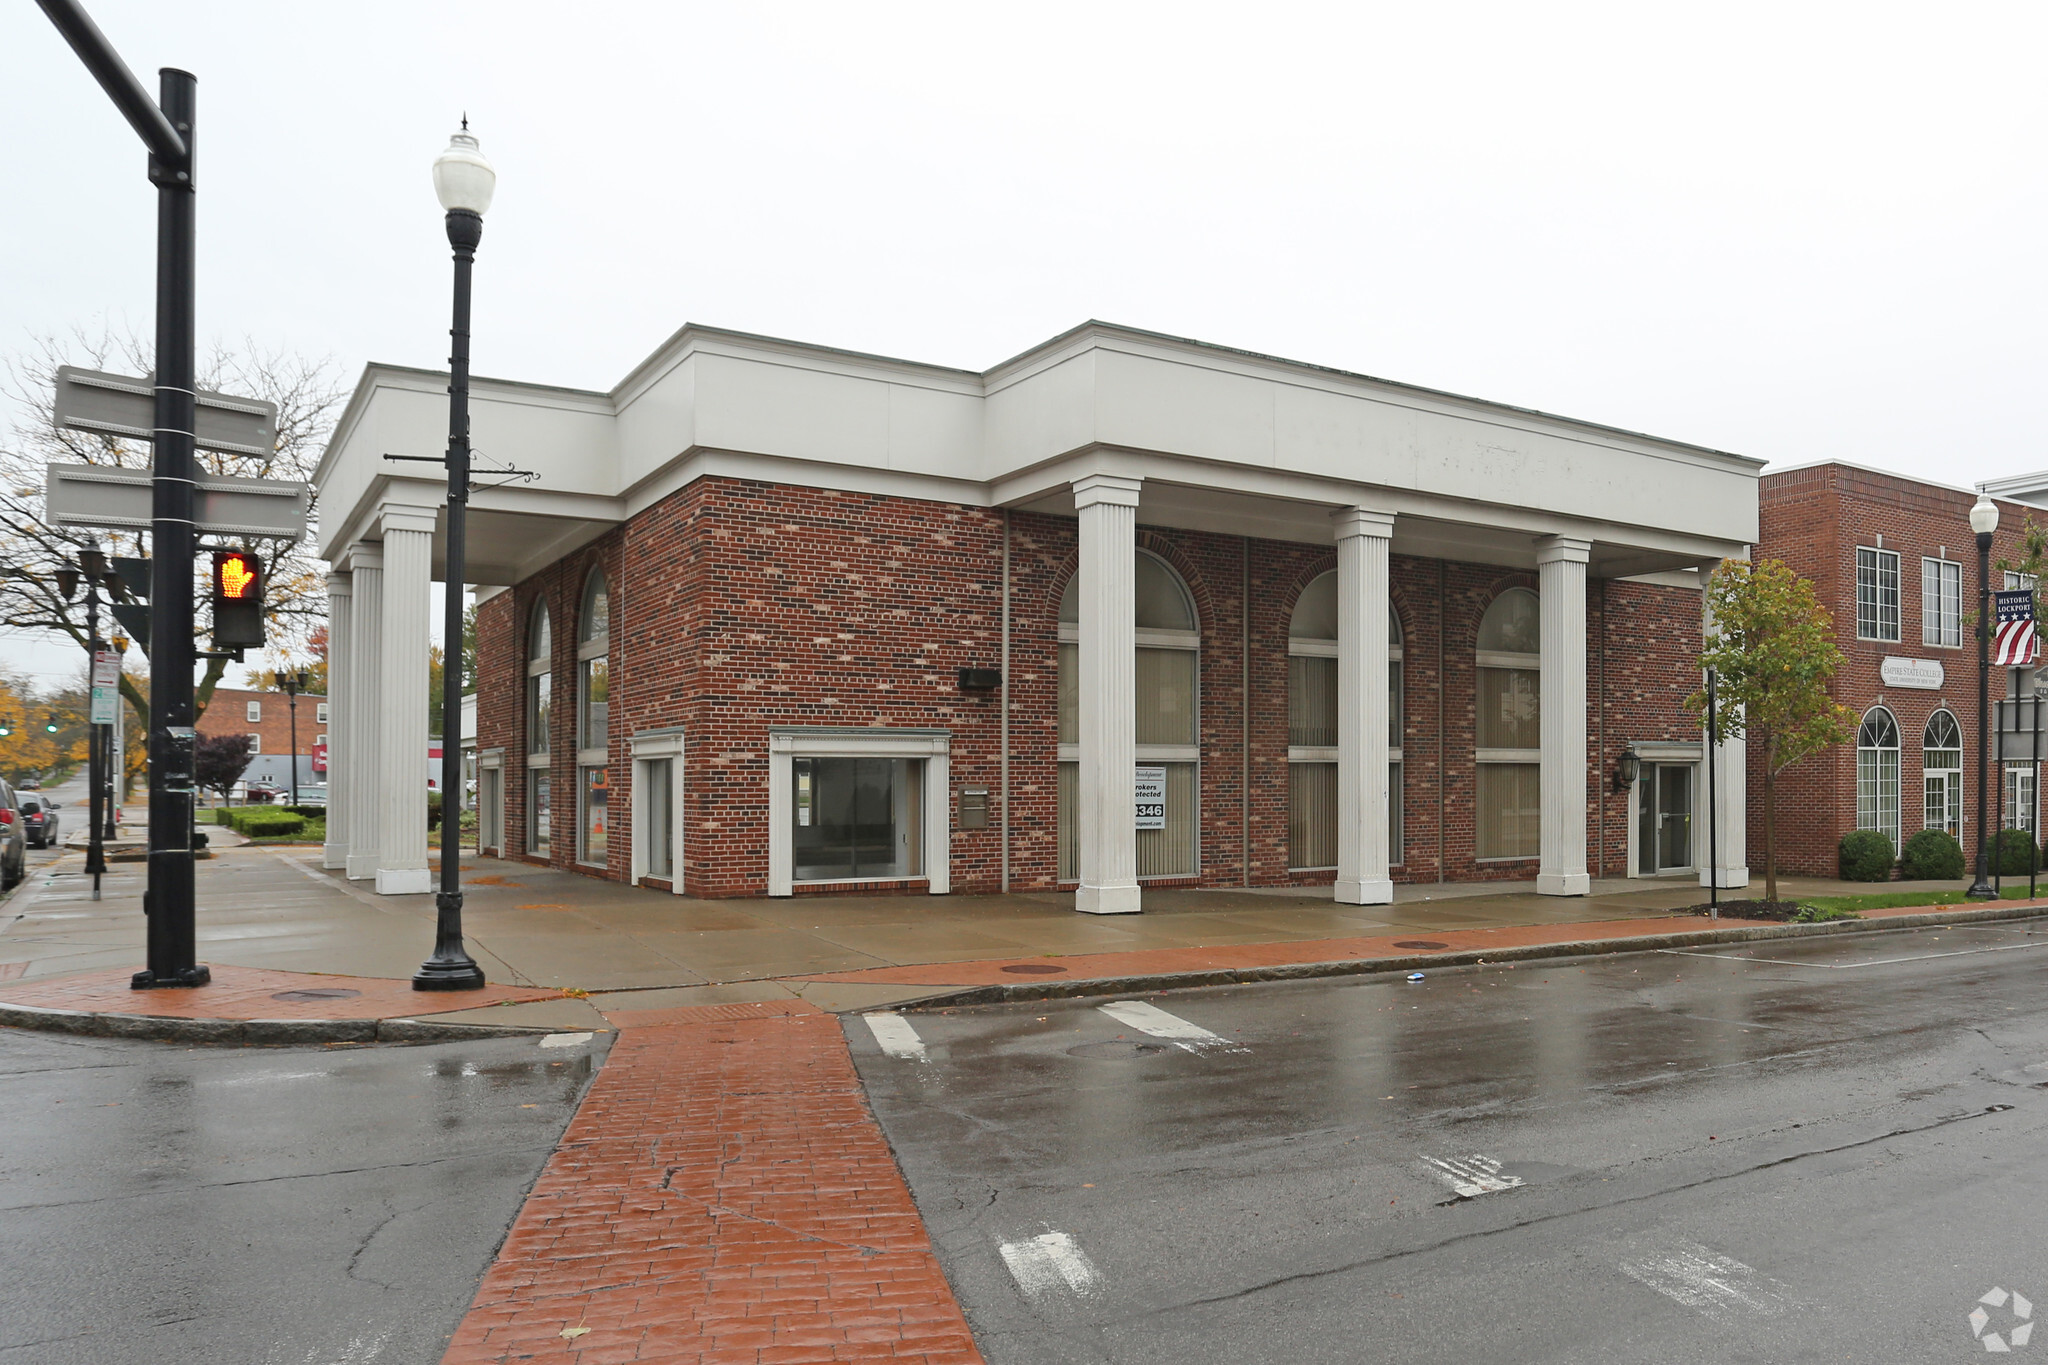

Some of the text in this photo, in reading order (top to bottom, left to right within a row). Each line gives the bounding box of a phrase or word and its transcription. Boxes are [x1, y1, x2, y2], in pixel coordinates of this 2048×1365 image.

[1998, 596, 2030, 605] HISTORIC
[1998, 604, 2031, 613] LOCKPORT
[1884, 665, 1942, 679] EMPIRE STATE COLLEGE
